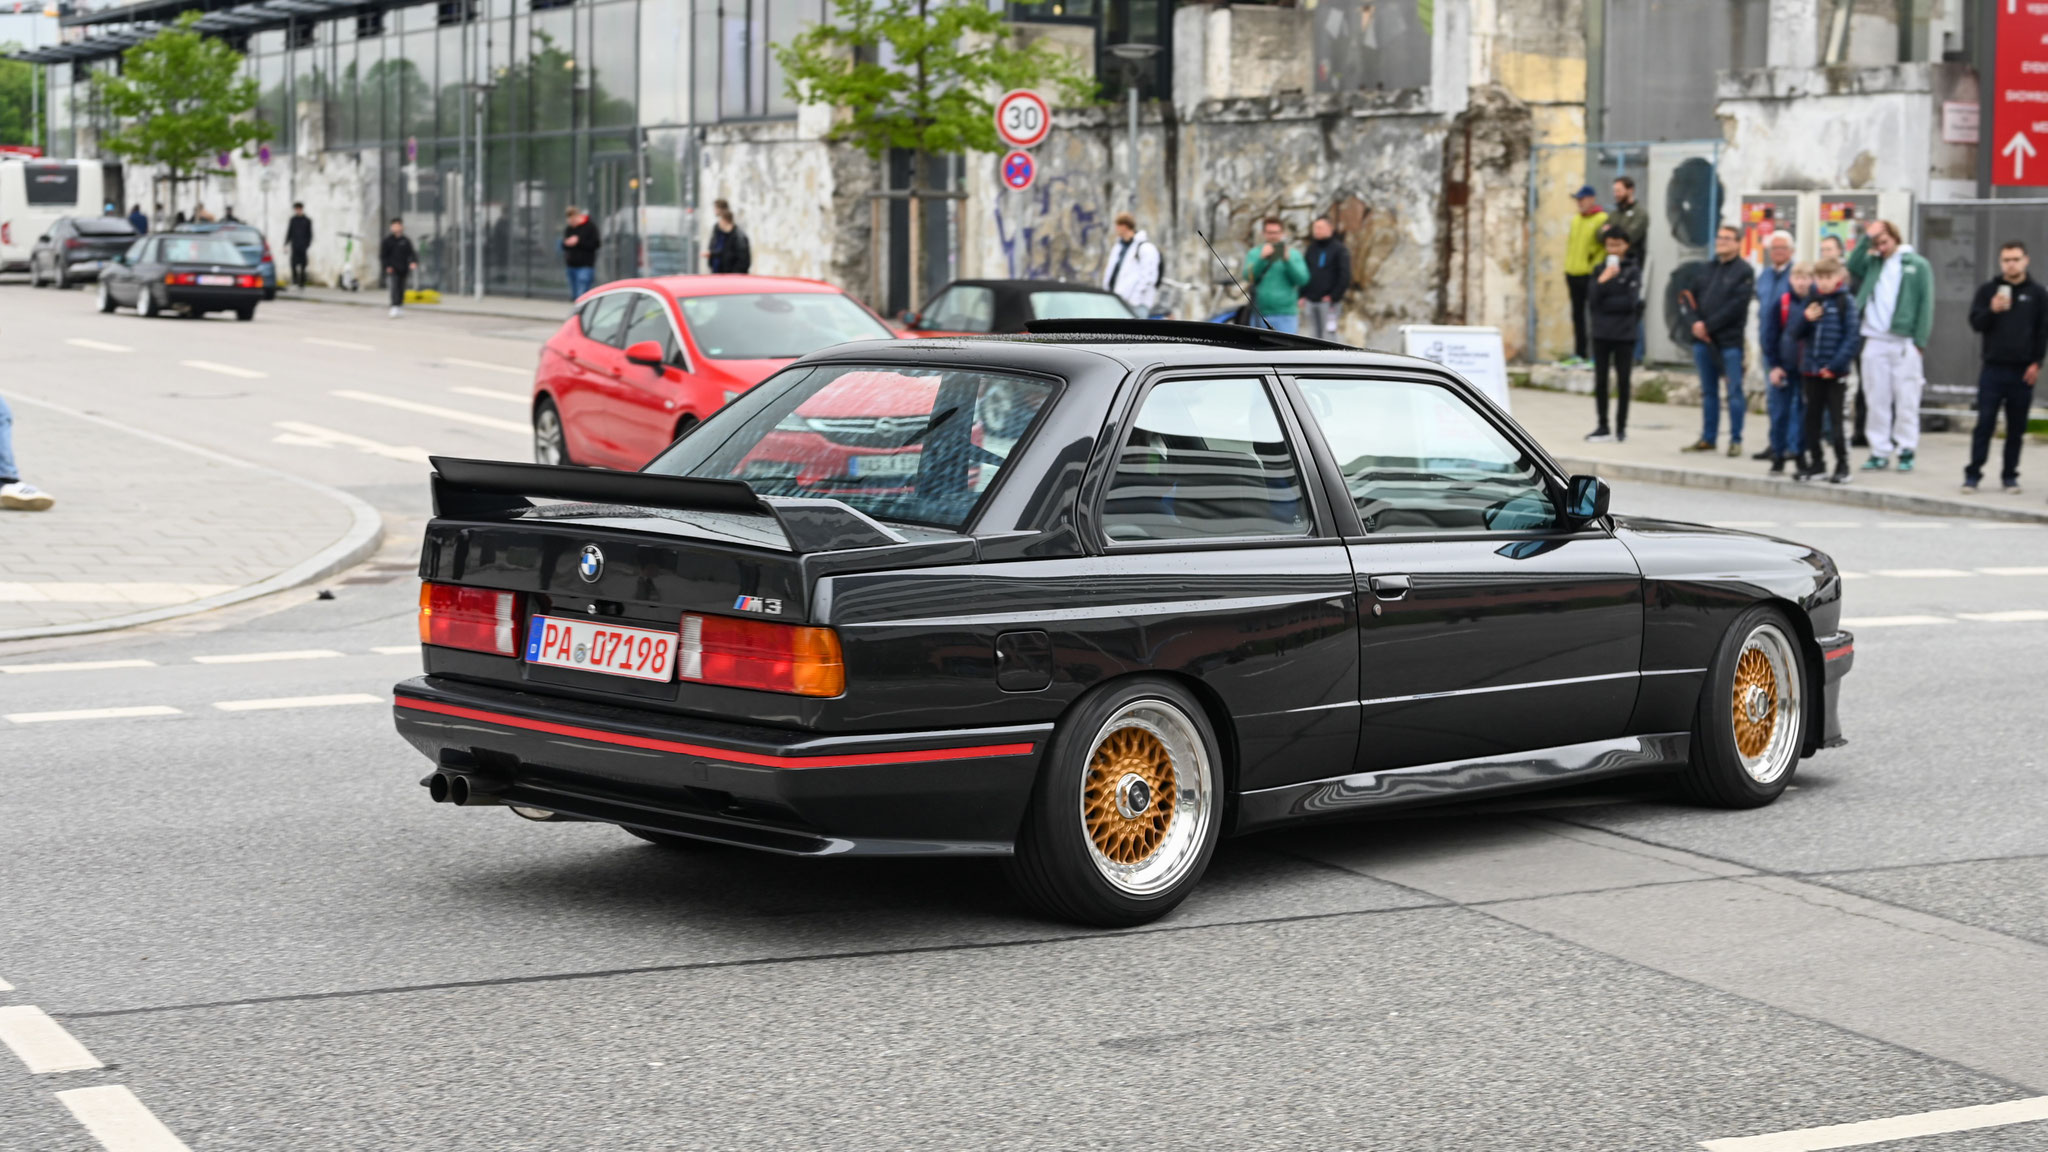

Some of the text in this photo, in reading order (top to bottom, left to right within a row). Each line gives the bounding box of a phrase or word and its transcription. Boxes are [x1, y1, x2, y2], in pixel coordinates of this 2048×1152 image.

[1008, 106, 1038, 131] 30
[745, 596, 783, 615] M3
[542, 623, 668, 674] PA 07198
